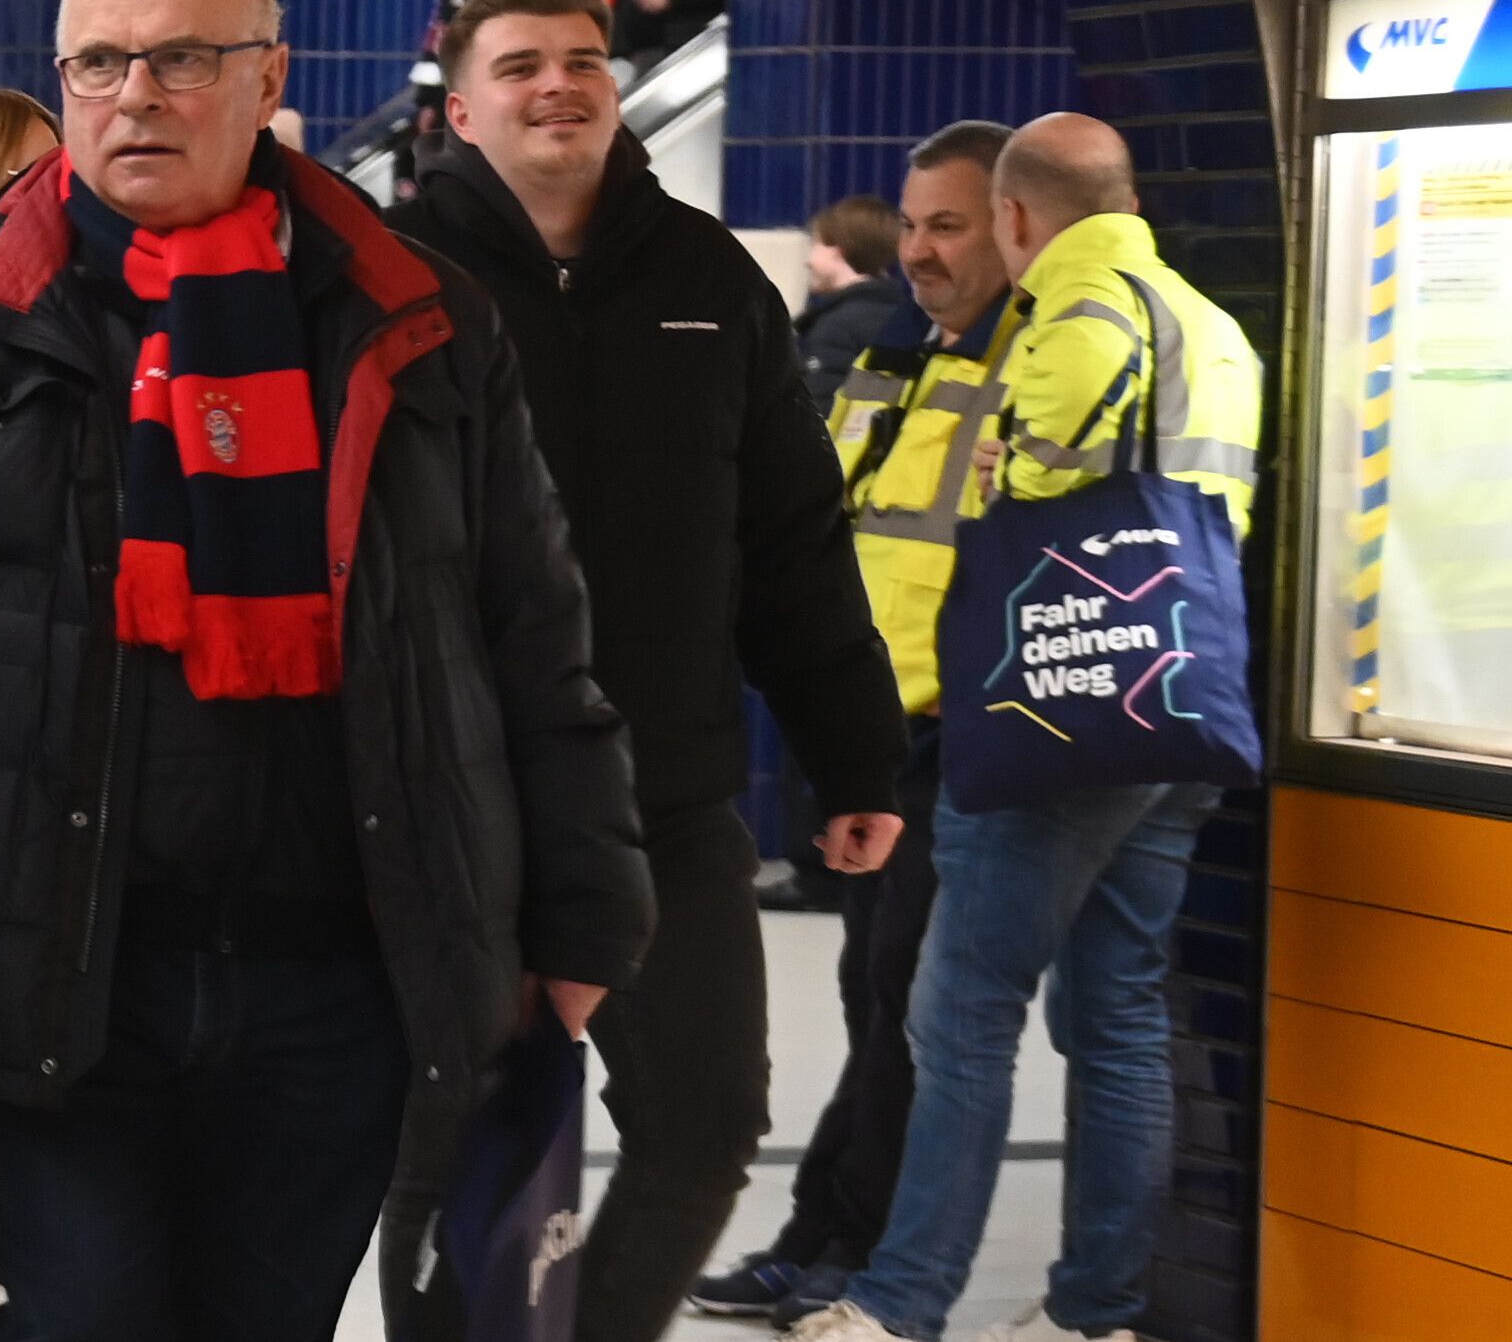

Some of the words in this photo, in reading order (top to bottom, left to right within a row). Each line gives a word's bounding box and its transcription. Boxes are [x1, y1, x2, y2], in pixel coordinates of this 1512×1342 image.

[1019, 593, 1109, 632] Fahr
[1021, 623, 1159, 665] deinen
[1022, 662, 1118, 700] Weg
